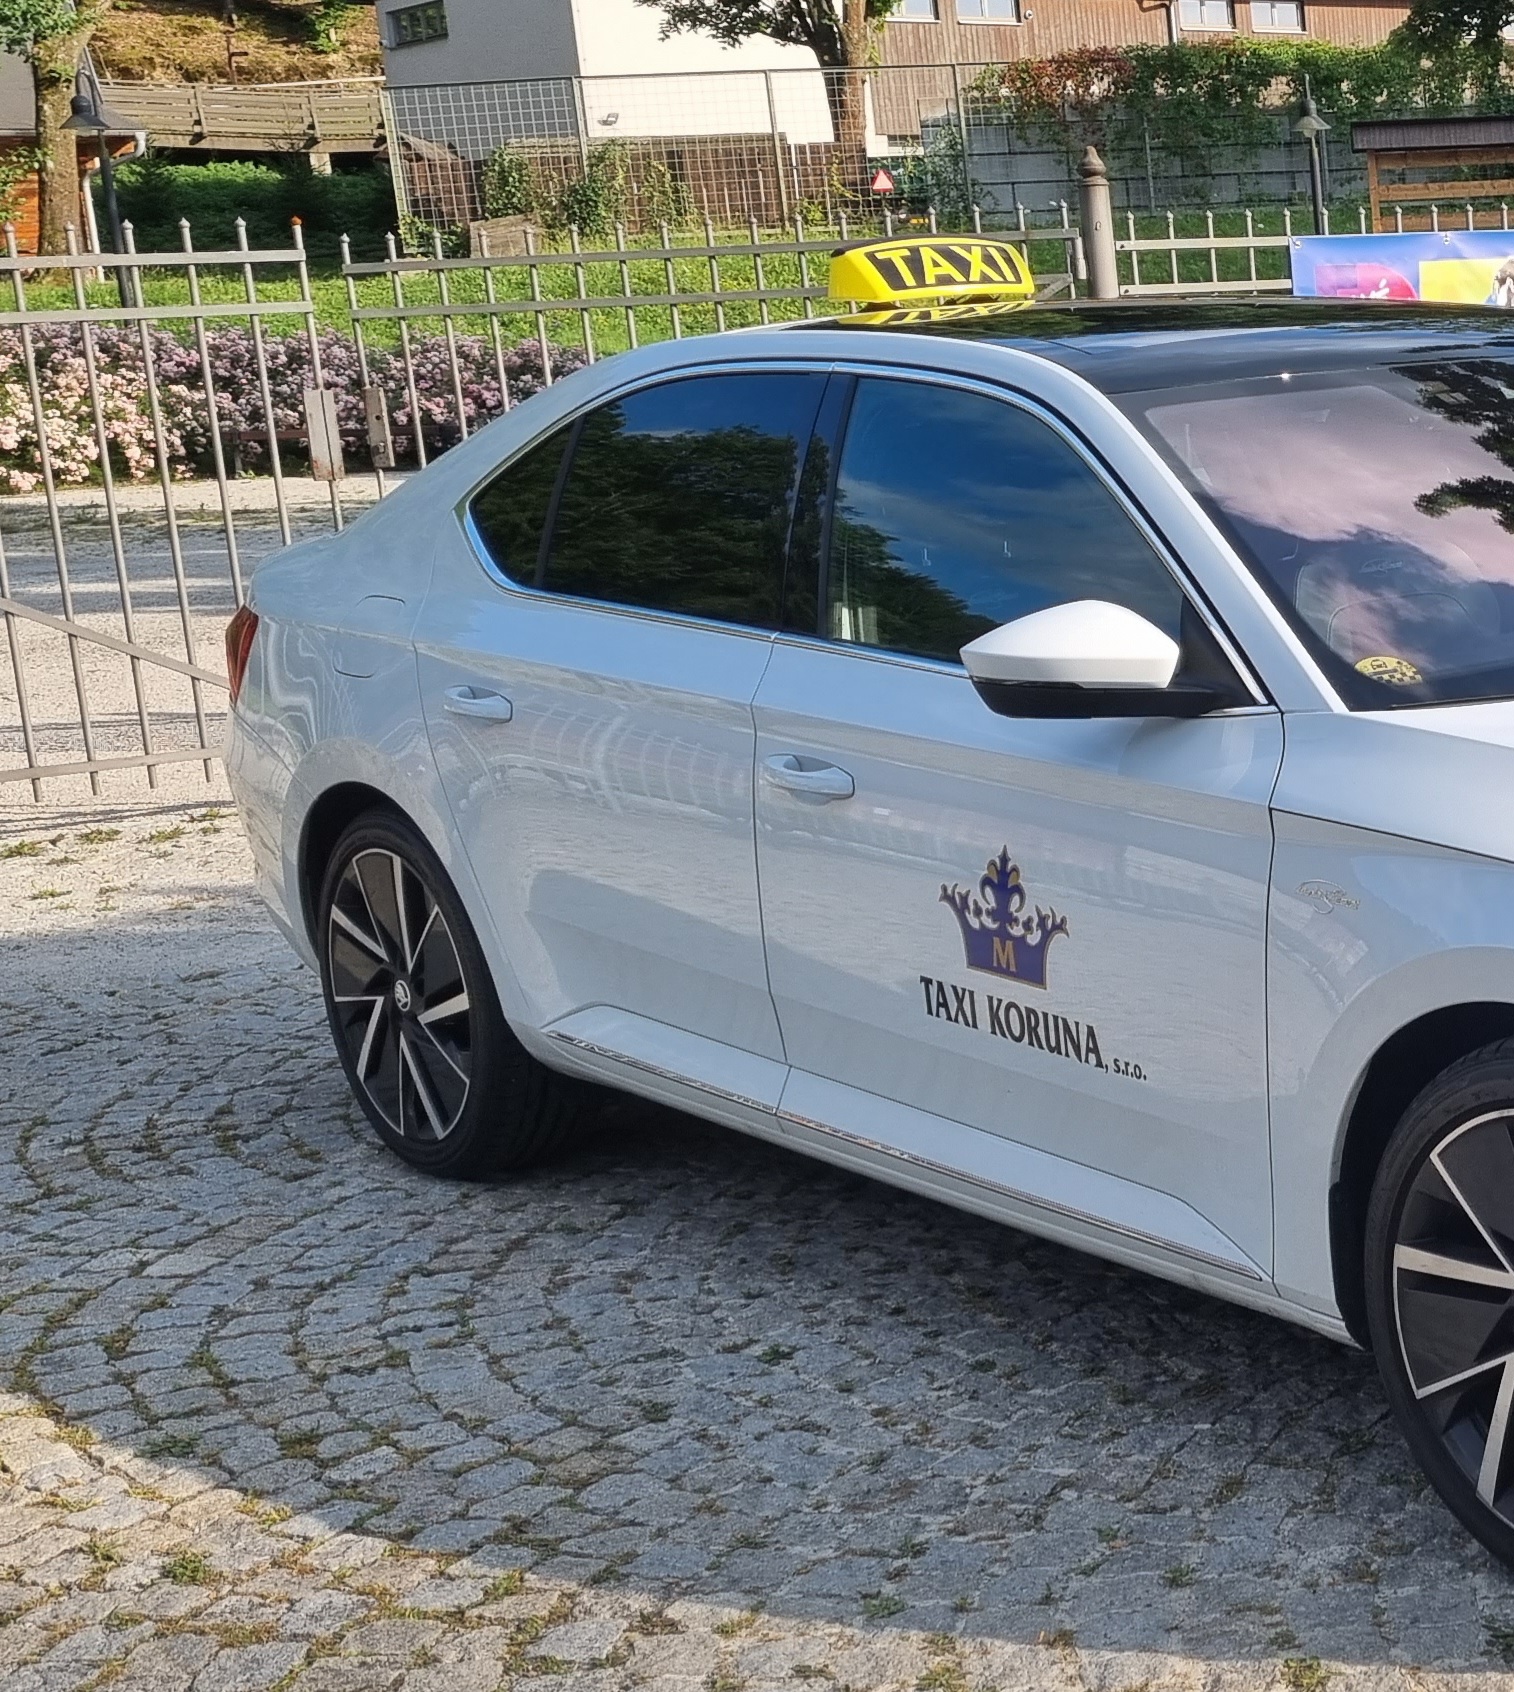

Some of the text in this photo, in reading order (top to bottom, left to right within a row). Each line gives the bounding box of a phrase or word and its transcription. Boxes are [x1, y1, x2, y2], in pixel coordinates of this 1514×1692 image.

[873, 245, 1017, 287] TAXI
[993, 936, 1016, 972] M
[919, 975, 1147, 1081] TAXI KORUNA, s.r.o.
